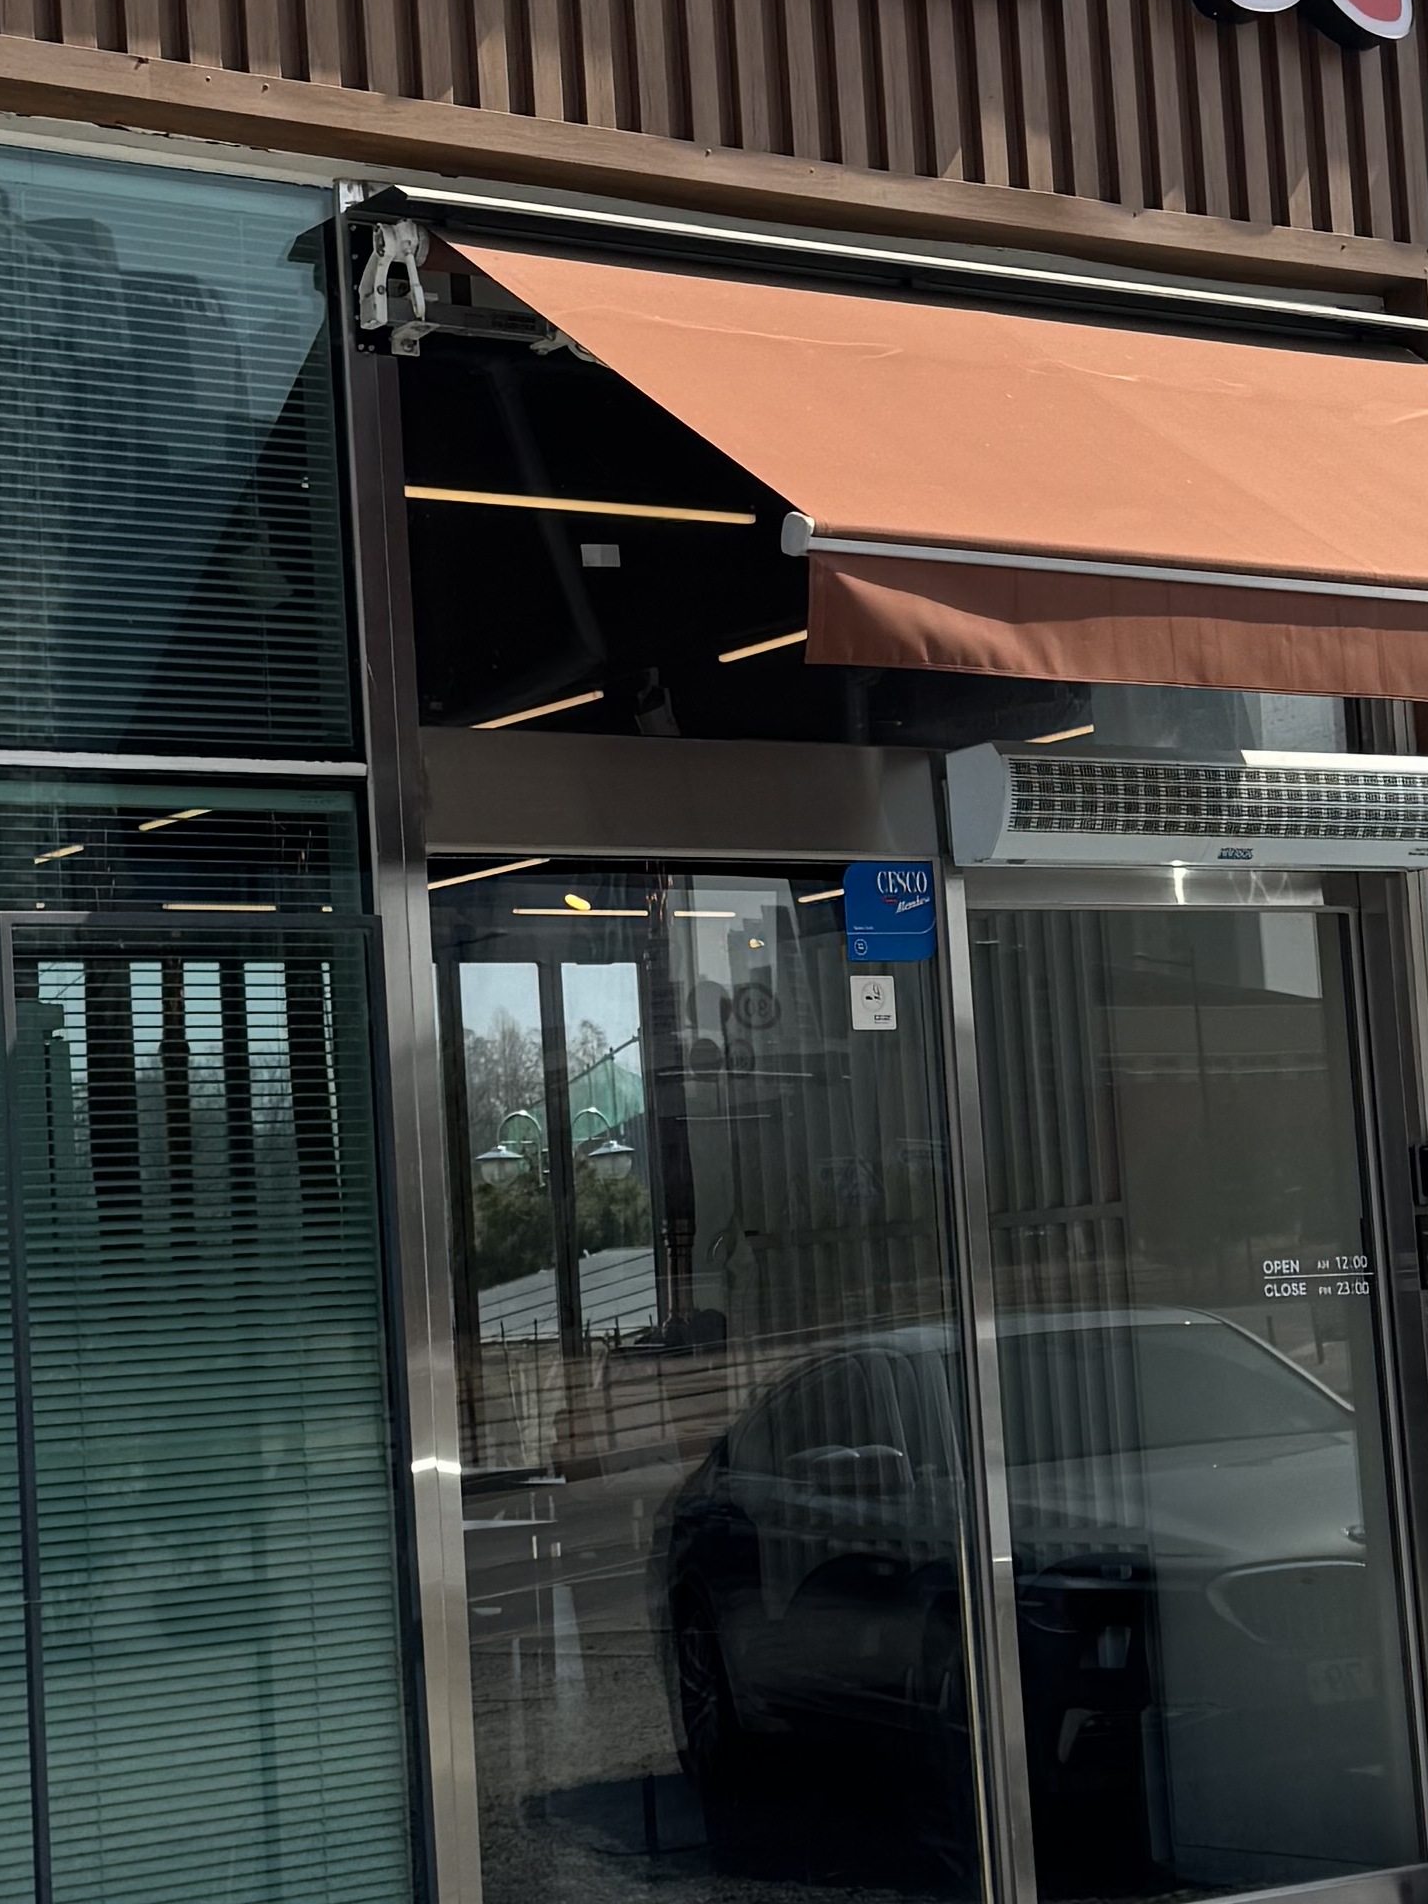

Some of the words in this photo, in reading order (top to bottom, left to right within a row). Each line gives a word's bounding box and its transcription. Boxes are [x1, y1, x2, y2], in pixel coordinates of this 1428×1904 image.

[877, 871, 927, 894] CESCO
[1263, 1259, 1300, 1274] OPEN
[1335, 1255, 1368, 1270] 12:00
[1264, 1282, 1307, 1297] CLOSE
[1337, 1281, 1370, 1296] 23:00
